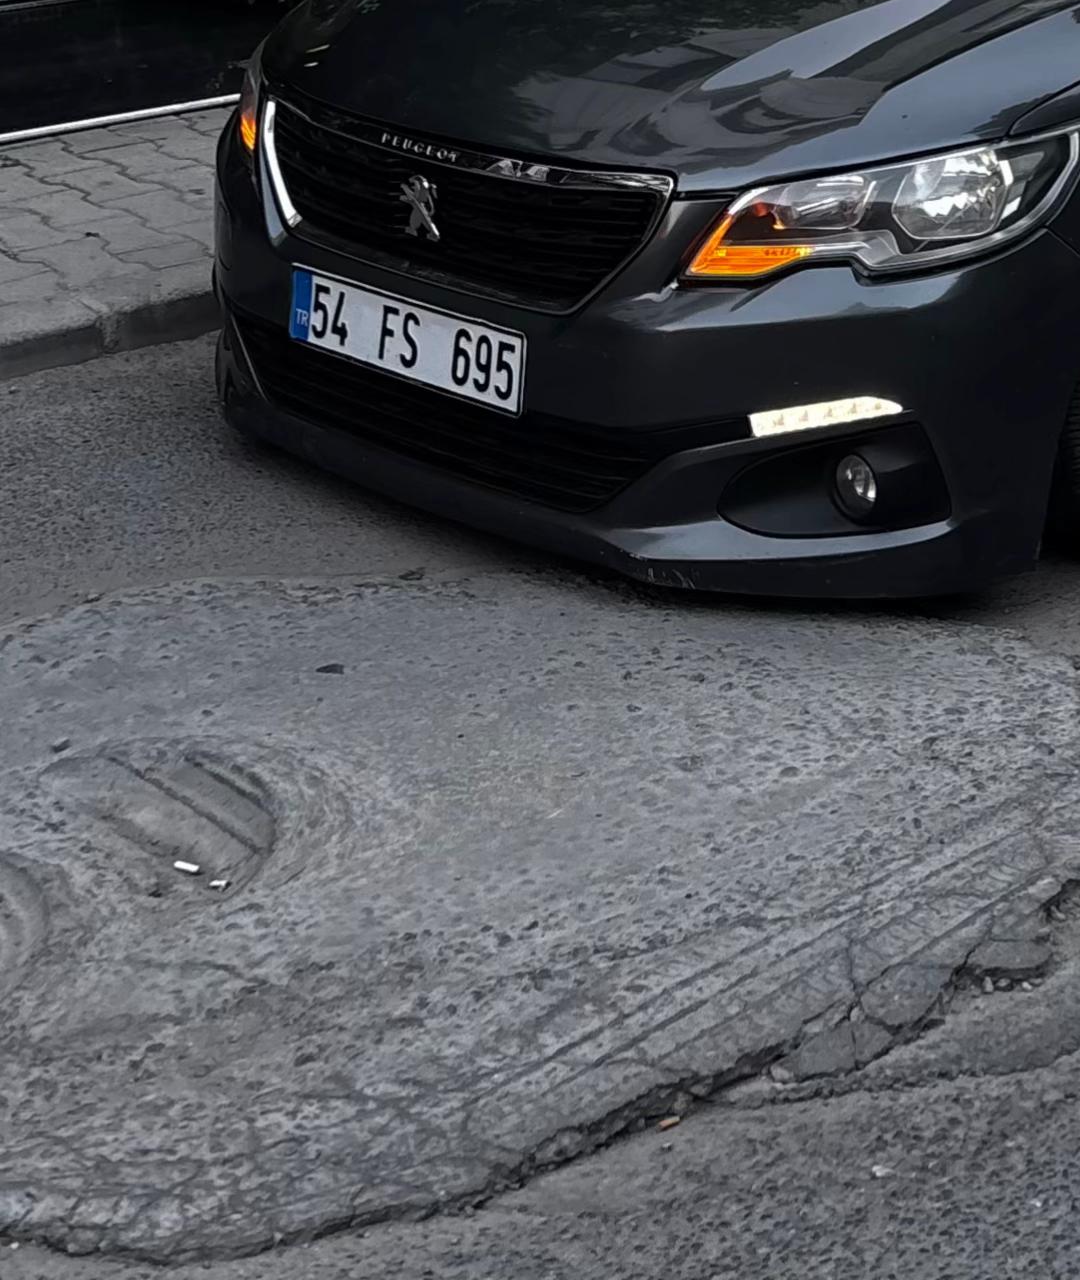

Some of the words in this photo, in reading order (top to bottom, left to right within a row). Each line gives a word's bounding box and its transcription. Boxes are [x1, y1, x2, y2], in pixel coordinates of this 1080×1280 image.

[381, 132, 457, 163] PEUGEOT
[295, 307, 309, 327] TR
[312, 283, 348, 346] 54
[378, 304, 421, 369] FS
[452, 328, 516, 401] 695
